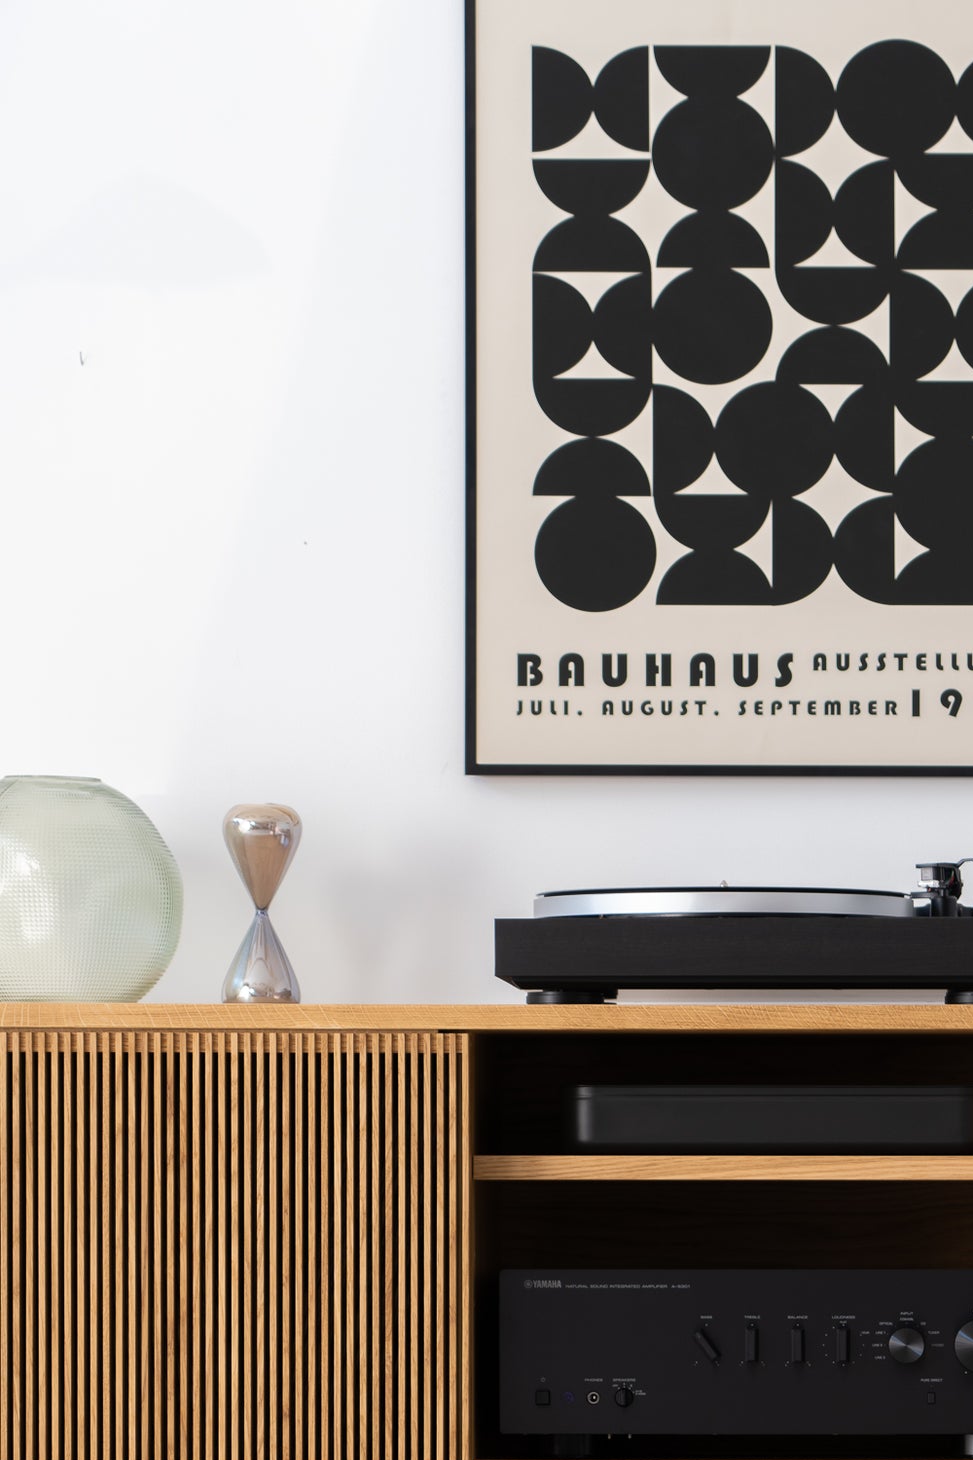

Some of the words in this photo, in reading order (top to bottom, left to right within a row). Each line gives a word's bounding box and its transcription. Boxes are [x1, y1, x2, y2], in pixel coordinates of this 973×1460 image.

[518, 653, 793, 687] BAUHAUS
[517, 701, 582, 716] JULI.
[602, 701, 718, 716] AUGUST.
[739, 701, 897, 715] SEPTEMBER
[533, 1280, 561, 1288] YAMAHA
